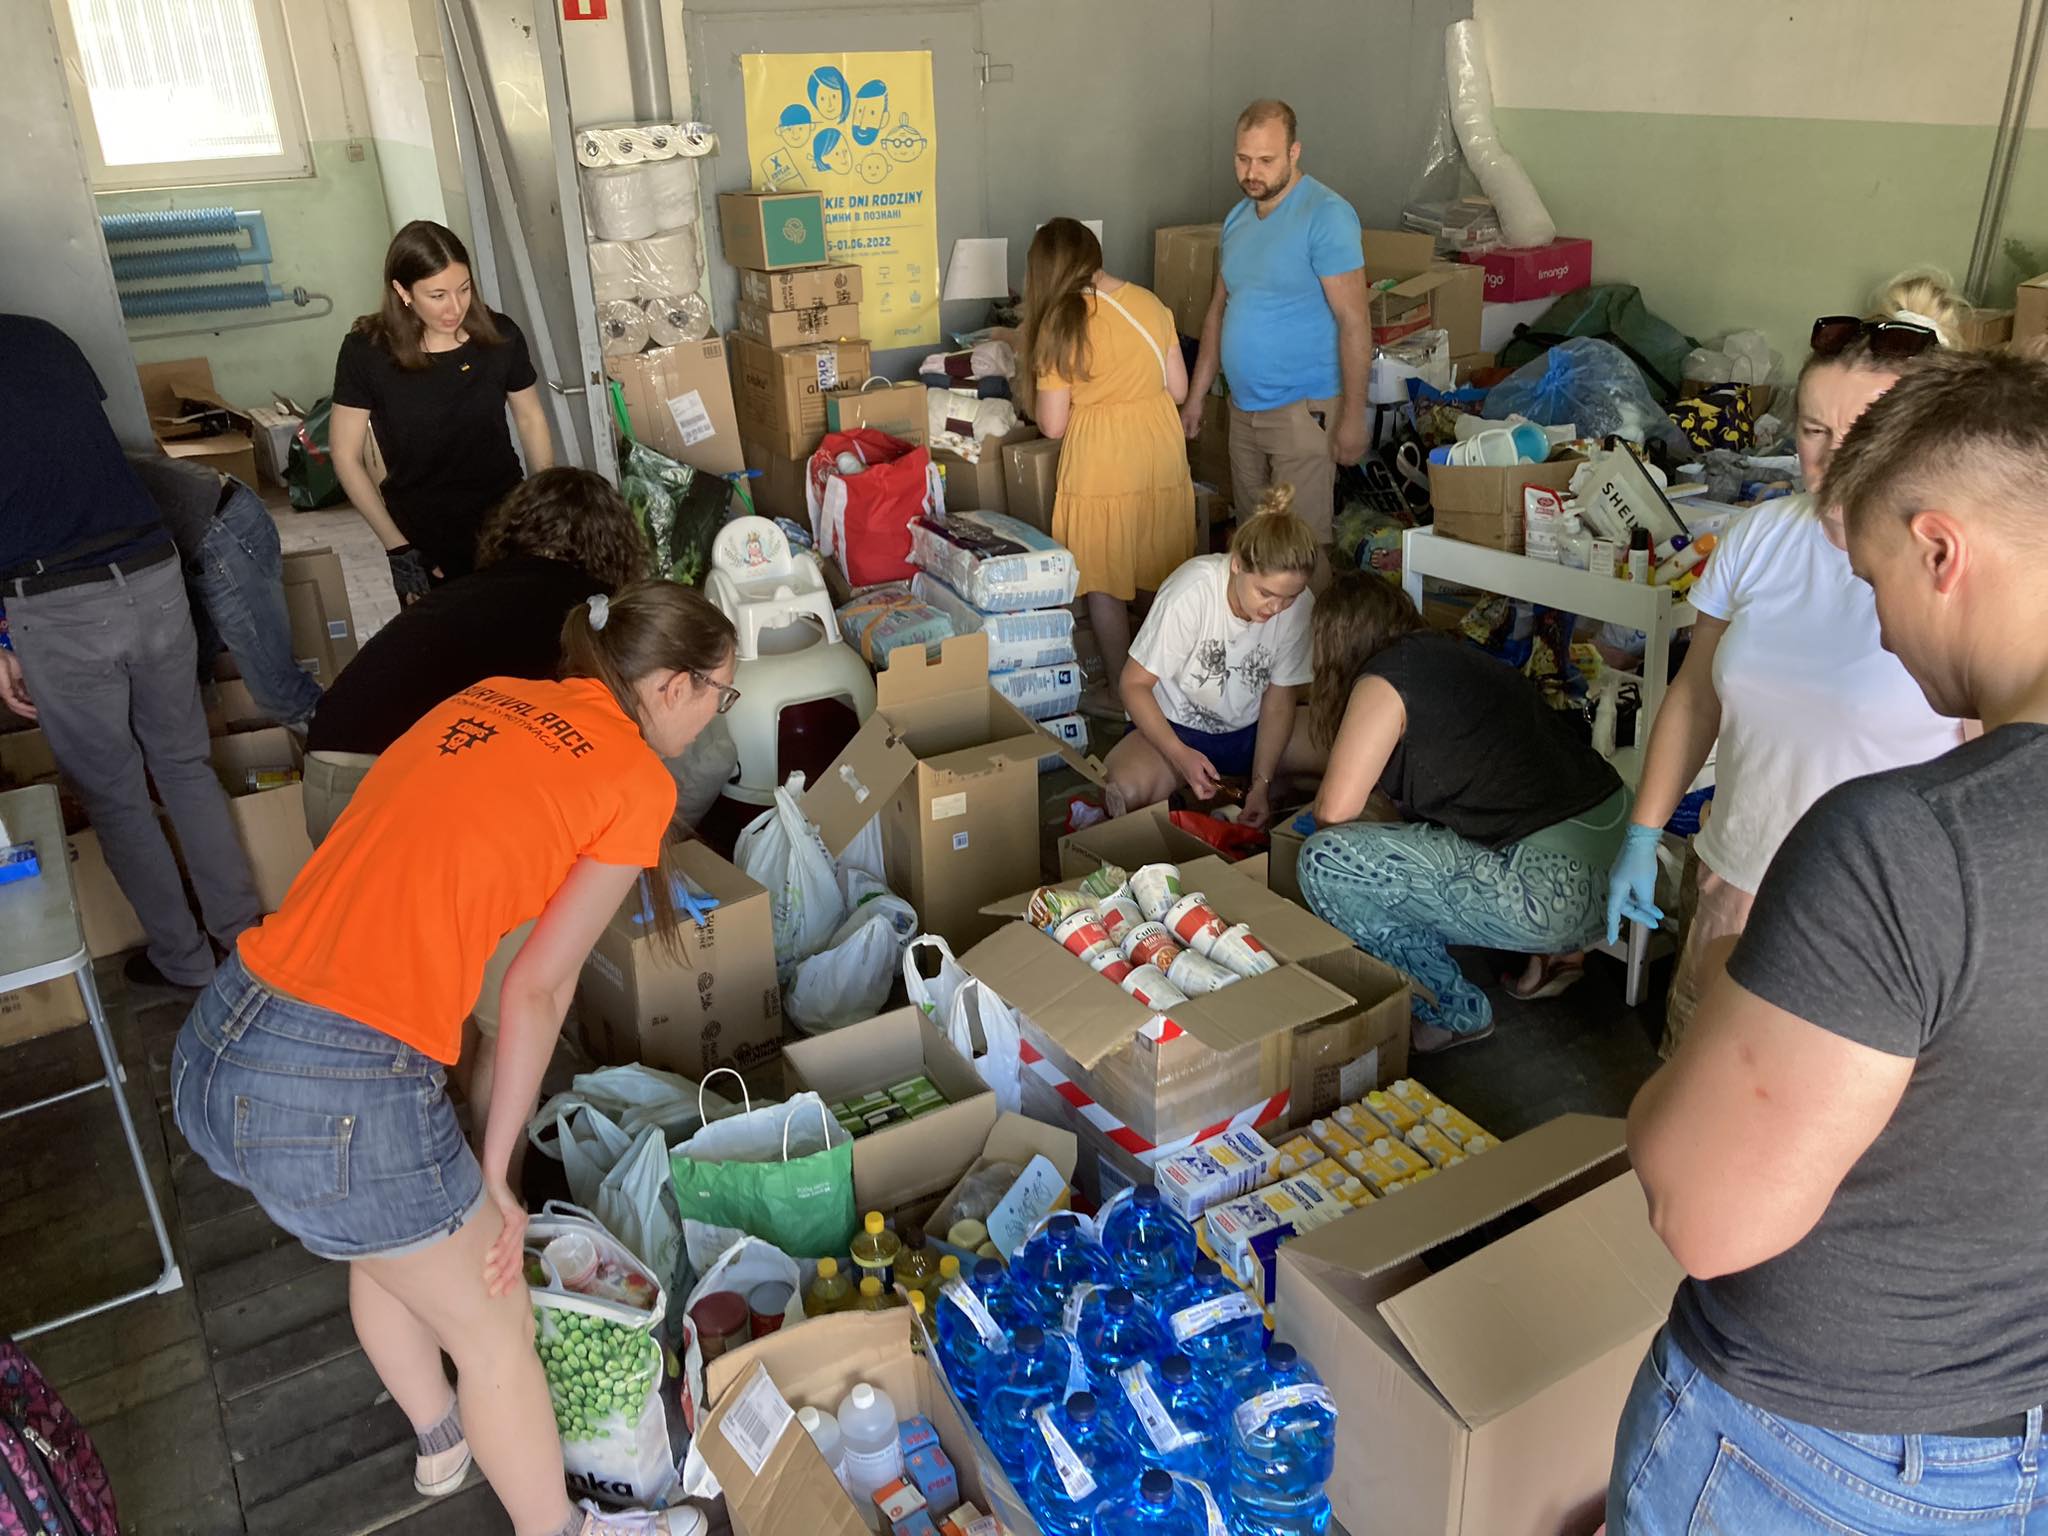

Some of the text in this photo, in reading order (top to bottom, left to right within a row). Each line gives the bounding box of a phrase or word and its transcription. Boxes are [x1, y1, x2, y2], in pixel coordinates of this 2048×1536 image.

[849, 192, 869, 208] DNI
[872, 190, 923, 207] RODZINY
[533, 711, 595, 759] RACE
